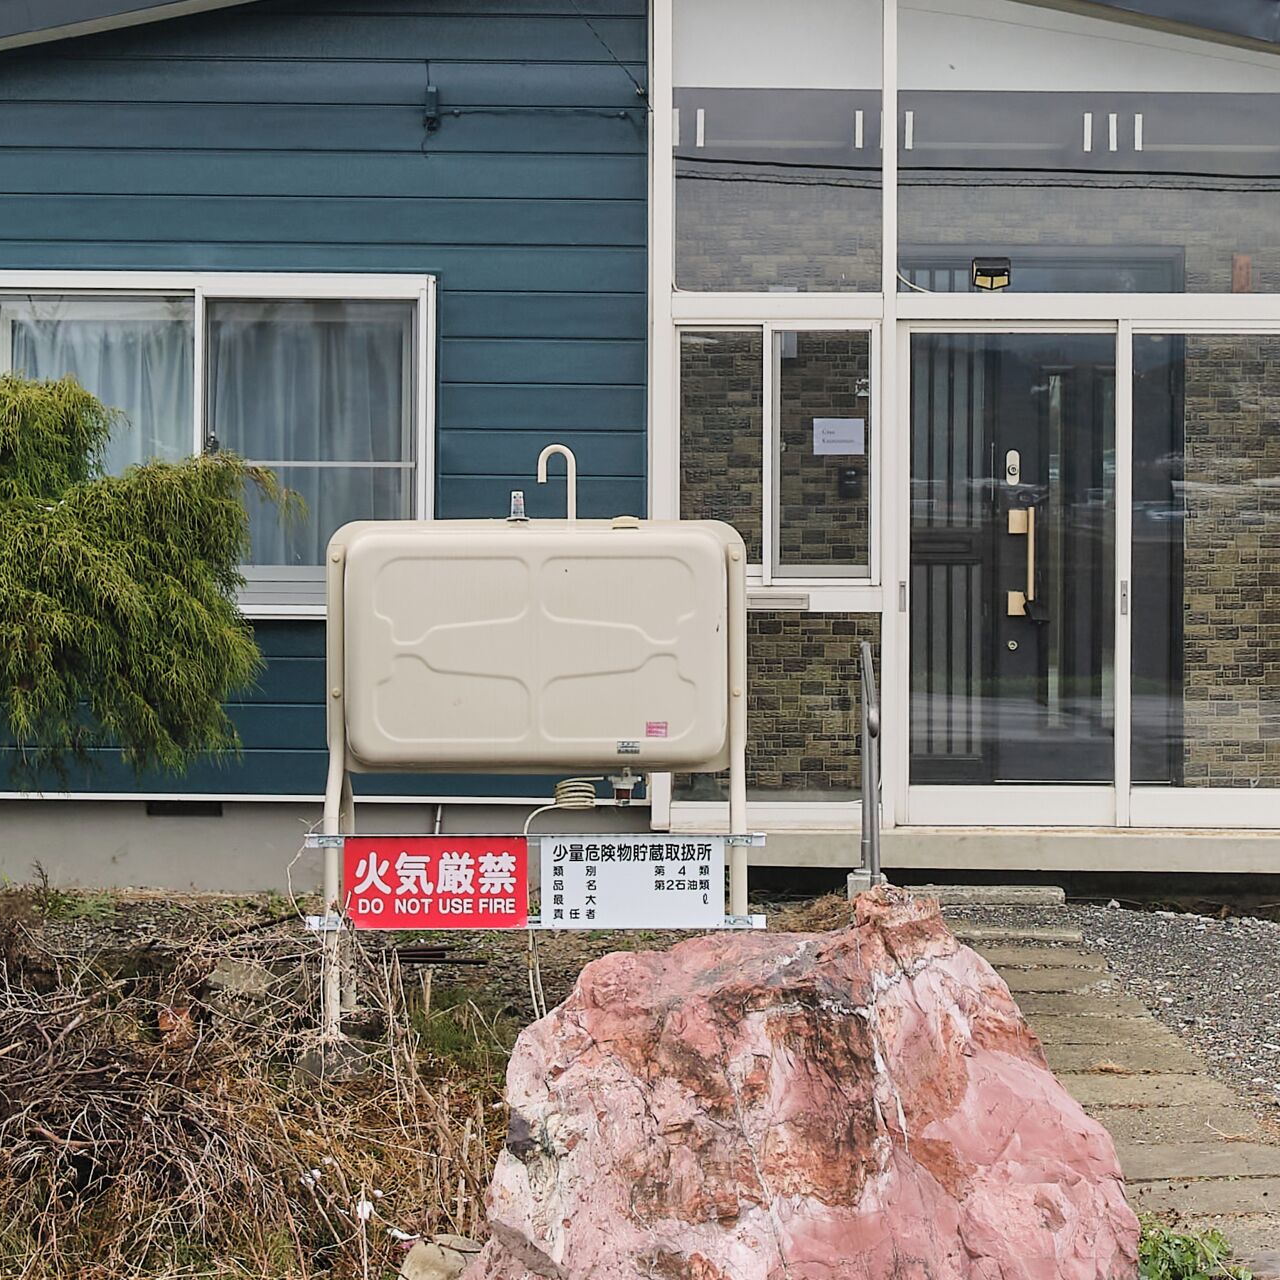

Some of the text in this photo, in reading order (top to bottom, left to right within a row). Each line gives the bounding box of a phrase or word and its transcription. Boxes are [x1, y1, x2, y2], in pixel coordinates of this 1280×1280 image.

[553, 843, 712, 862] 少量危険物貯蔵取扱所
[353, 851, 517, 895] 火気厳禁
[654, 879, 710, 891] 第2石油類
[357, 898, 516, 914] DO NOT USE FIRE
[553, 908, 597, 920] 責任者
